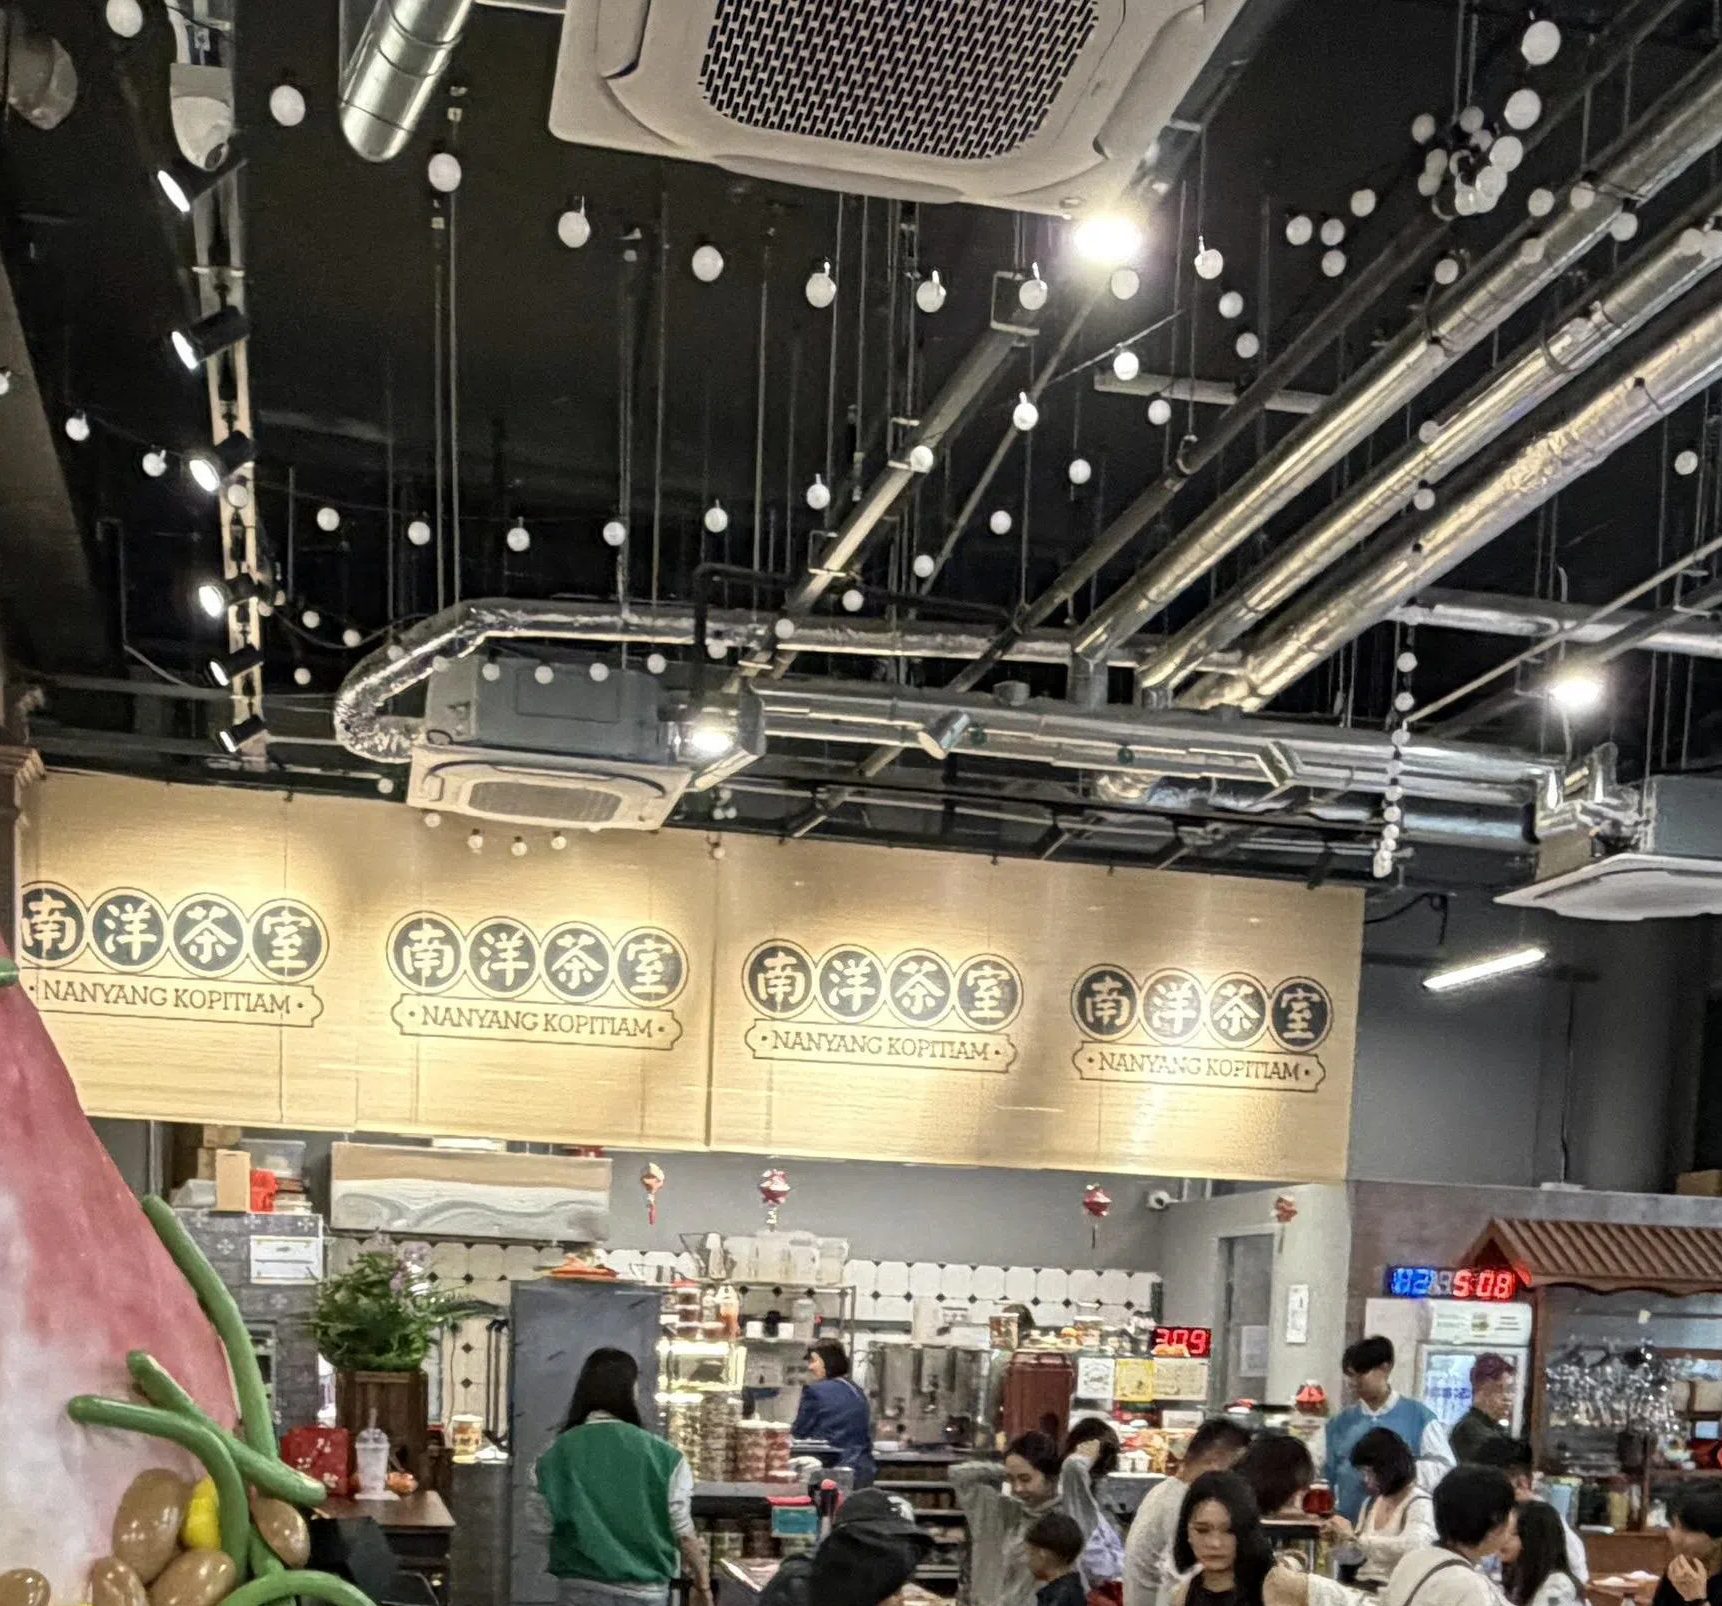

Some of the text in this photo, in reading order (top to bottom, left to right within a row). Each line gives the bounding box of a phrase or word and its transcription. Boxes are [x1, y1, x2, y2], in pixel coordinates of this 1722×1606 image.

[21, 892, 312, 969] 南洋茶室
[402, 923, 674, 995] 南洋茶室
[43, 979, 291, 1014] NANYANG KOPITIAM
[757, 951, 1012, 1019] 南洋茶室
[1085, 975, 1321, 1040] 南洋茶室
[421, 1005, 653, 1038] NANYANG KOPITIAM
[772, 1030, 990, 1061] NANYANG KOPITIAM
[1098, 1052, 1300, 1081] NANYANG KOPITIAM
